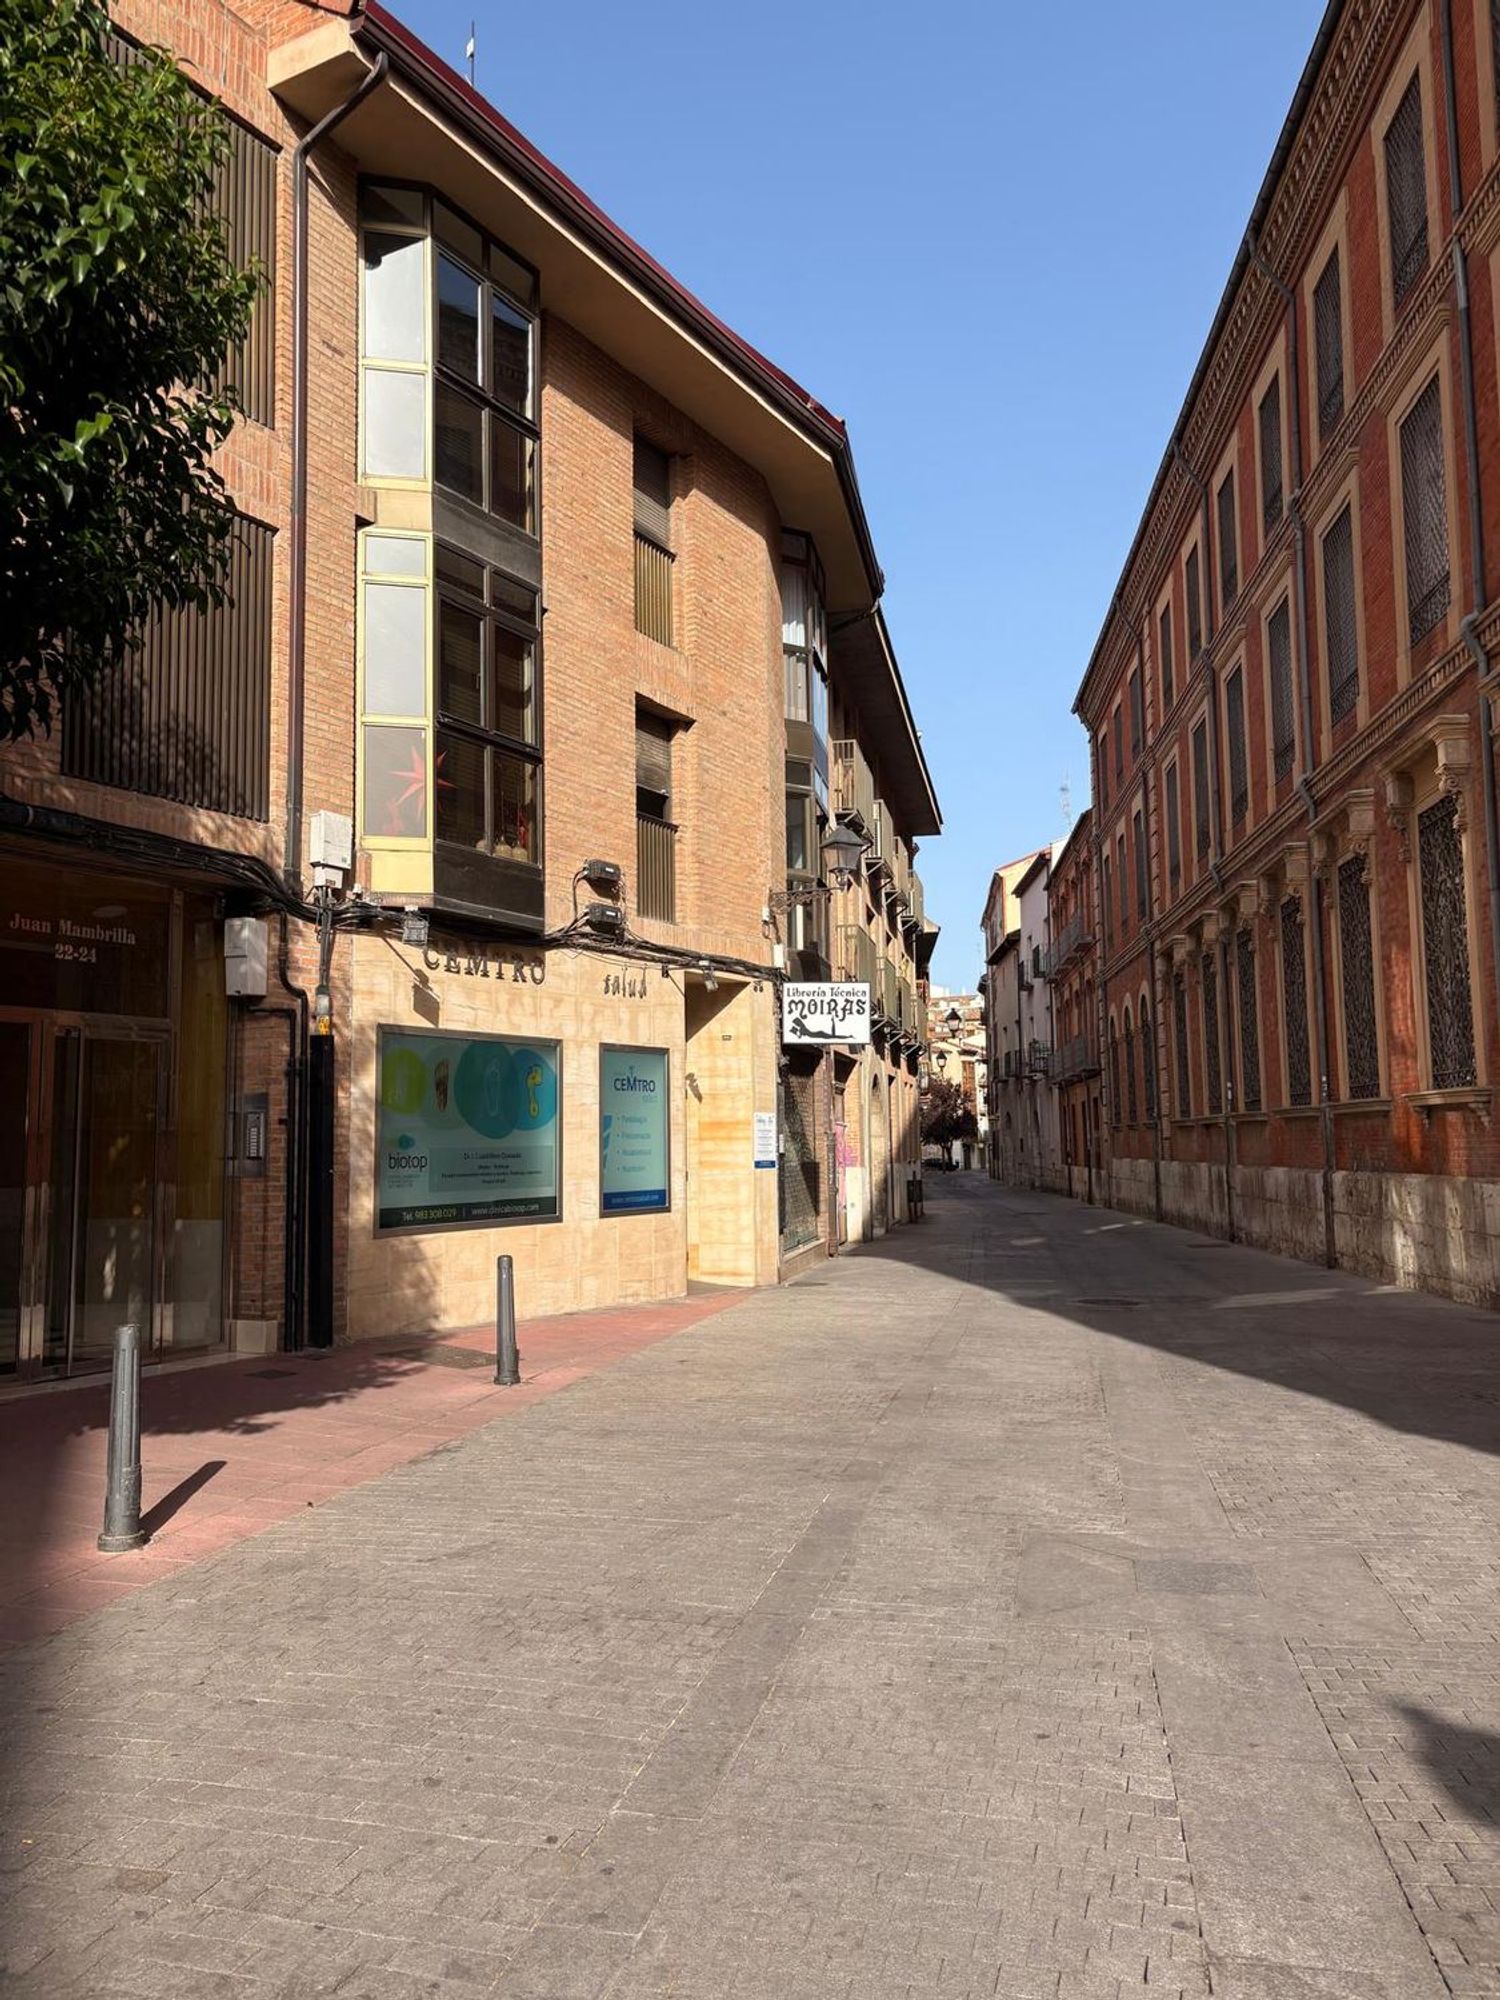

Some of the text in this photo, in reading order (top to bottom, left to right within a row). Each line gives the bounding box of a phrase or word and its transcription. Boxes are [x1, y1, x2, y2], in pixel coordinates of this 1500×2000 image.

[10, 912, 136, 945] Juan Mambrilla
[54, 943, 97, 963] 22-24
[423, 948, 546, 985] CEMTRO
[603, 964, 648, 999] salud
[786, 986, 867, 998] Librería Técnica
[787, 998, 867, 1022] MOIRAS
[613, 1075, 656, 1093] CEMTRO
[387, 1152, 428, 1172] biotop
